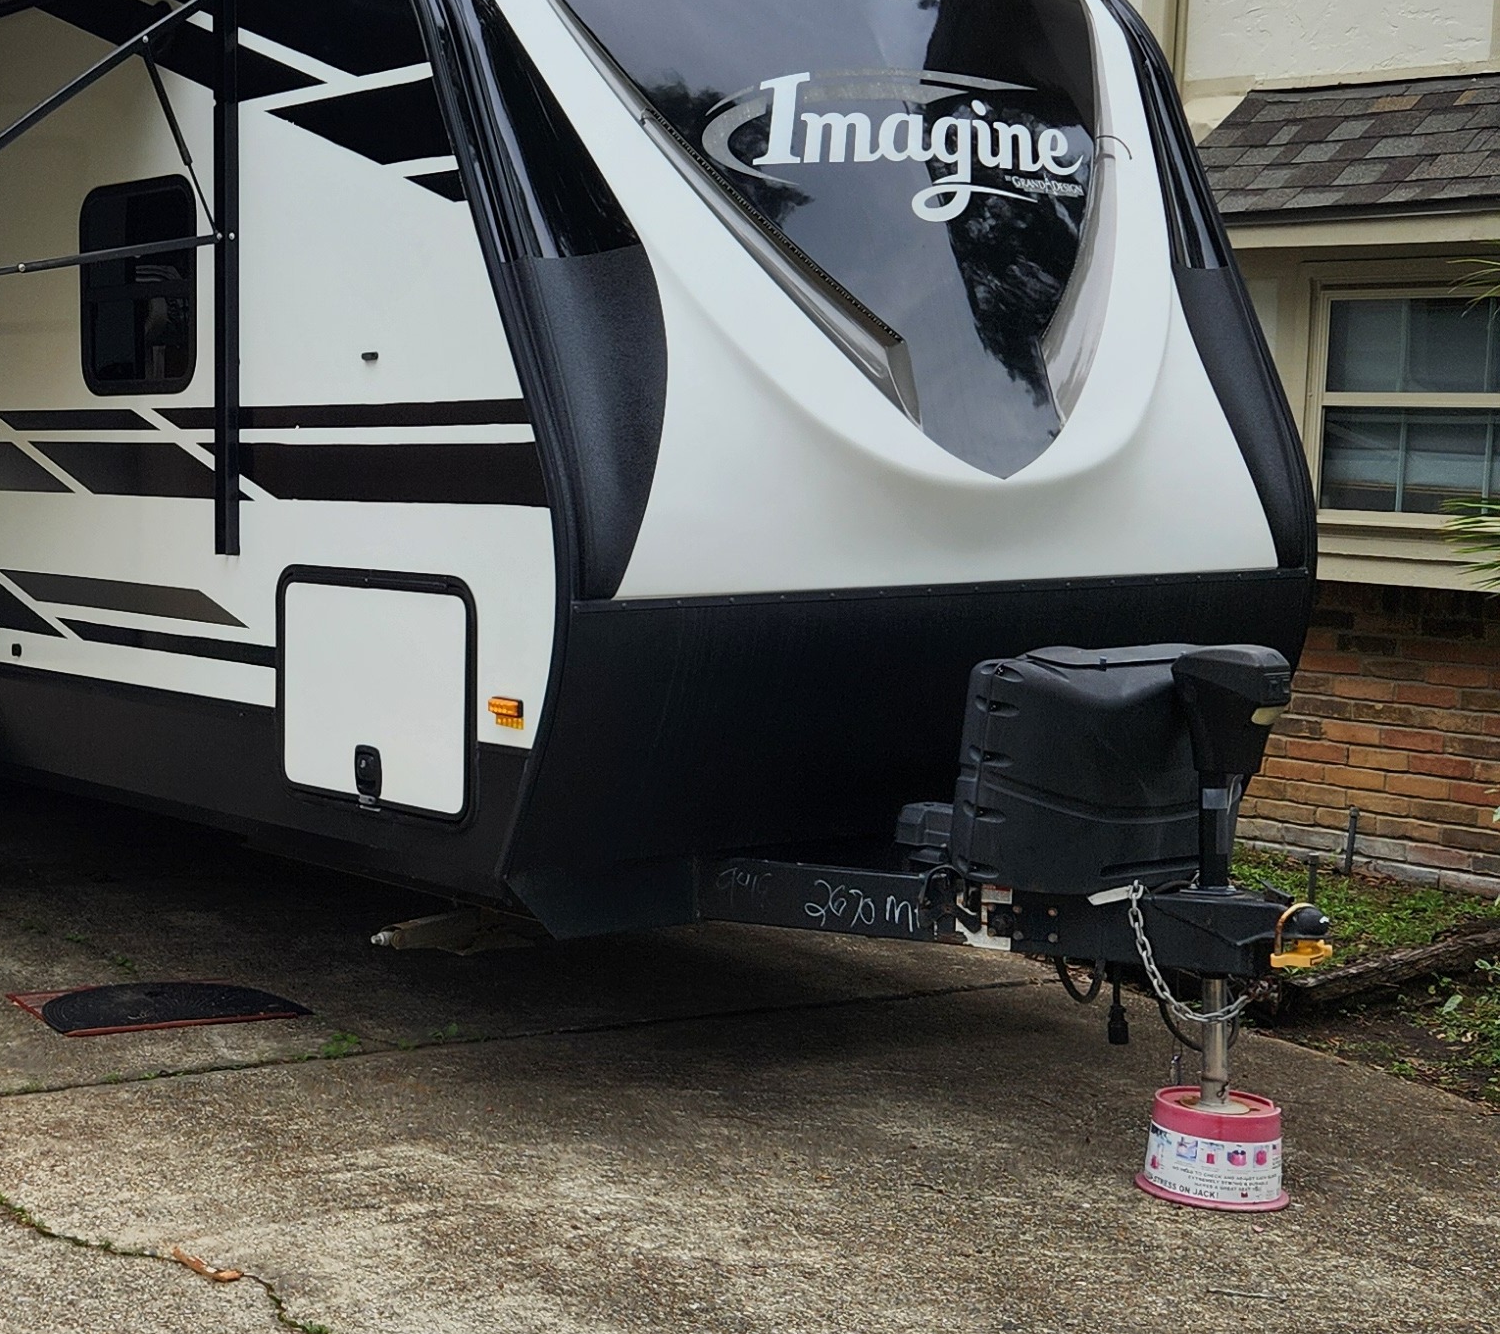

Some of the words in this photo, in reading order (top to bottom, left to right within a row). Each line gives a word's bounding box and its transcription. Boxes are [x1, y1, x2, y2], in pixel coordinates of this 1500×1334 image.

[752, 71, 1084, 223] Imagine
[885, 894, 921, 933] M
[1153, 1175, 1177, 1191] STRESS
[1178, 1184, 1191, 1195] ON
[1192, 1188, 1219, 1199] JACK!
